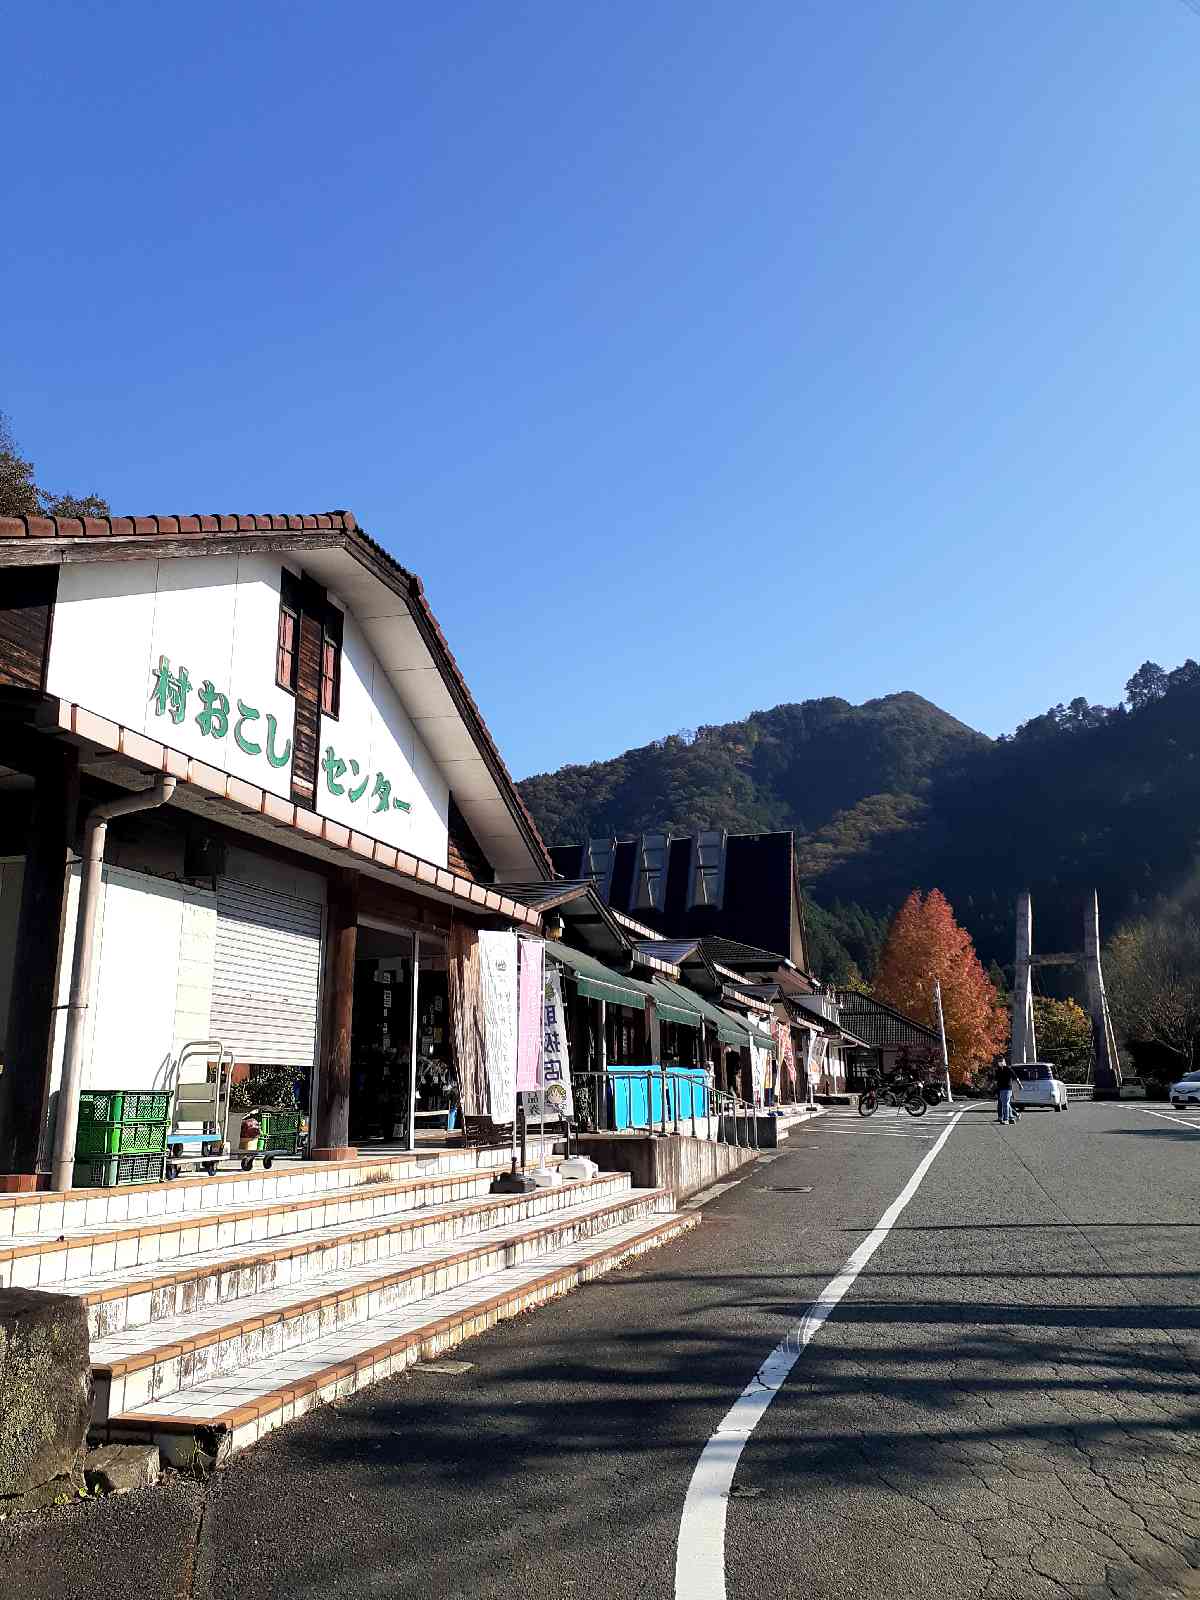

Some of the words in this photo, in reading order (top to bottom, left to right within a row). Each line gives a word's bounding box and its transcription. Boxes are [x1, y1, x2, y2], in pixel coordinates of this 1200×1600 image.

[149, 654, 291, 768] 村おこし
[322, 745, 411, 814] センター
